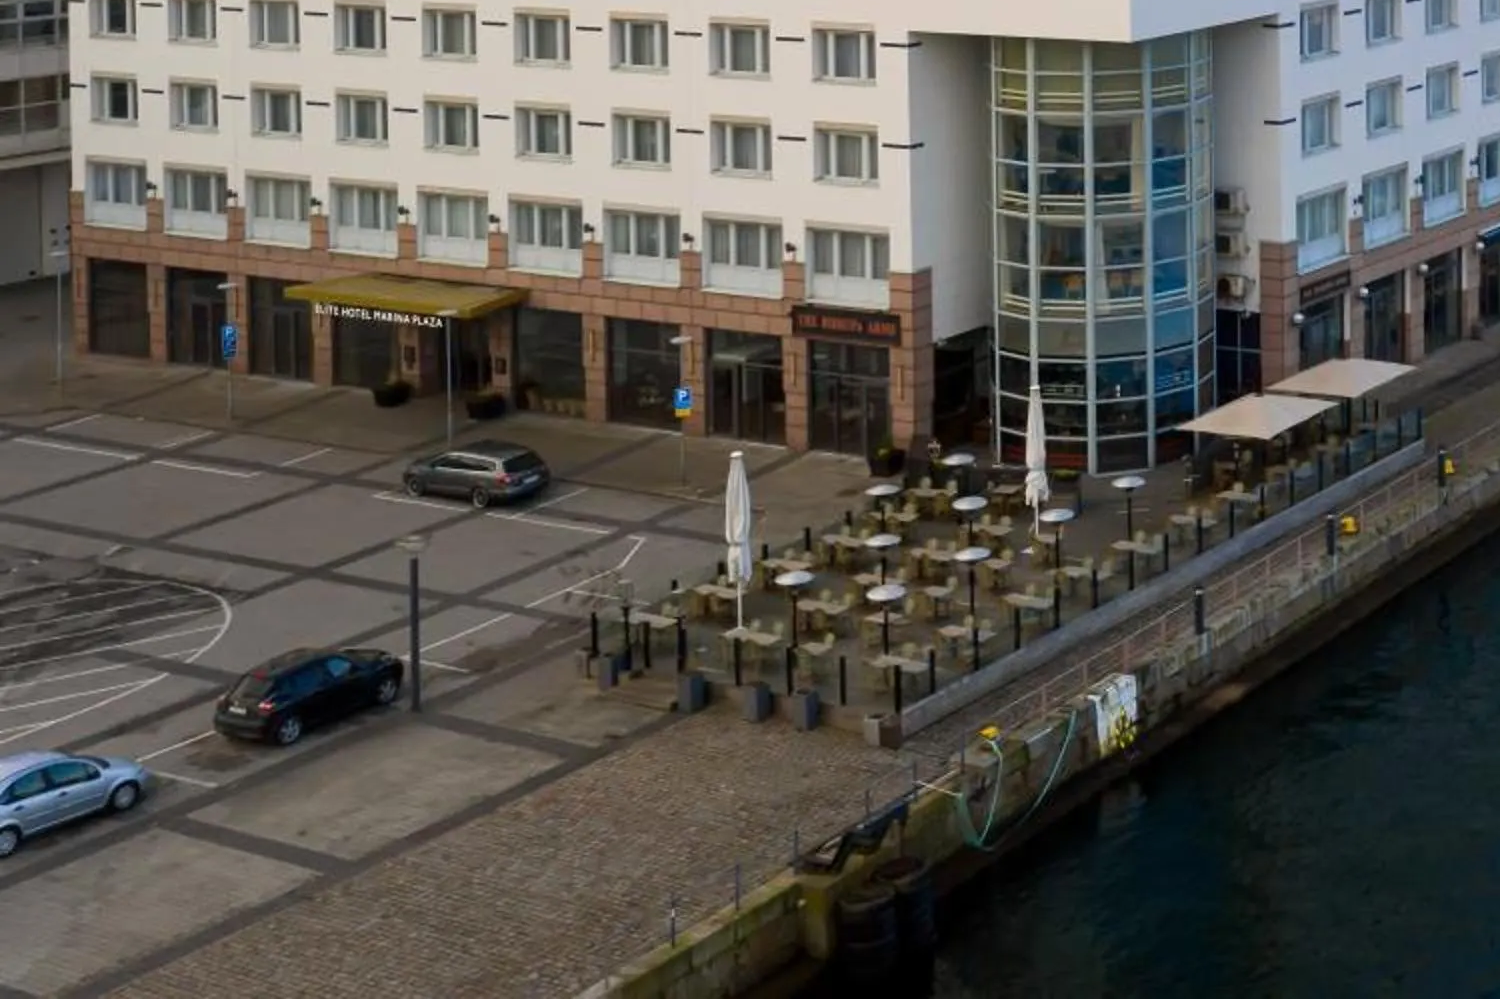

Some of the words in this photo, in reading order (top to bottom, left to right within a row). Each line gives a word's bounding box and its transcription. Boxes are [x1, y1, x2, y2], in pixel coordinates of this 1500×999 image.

[315, 304, 339, 316] ELITE
[341, 307, 372, 320] HOTEL
[373, 310, 410, 324] MARINA
[412, 314, 443, 328] PLAZA
